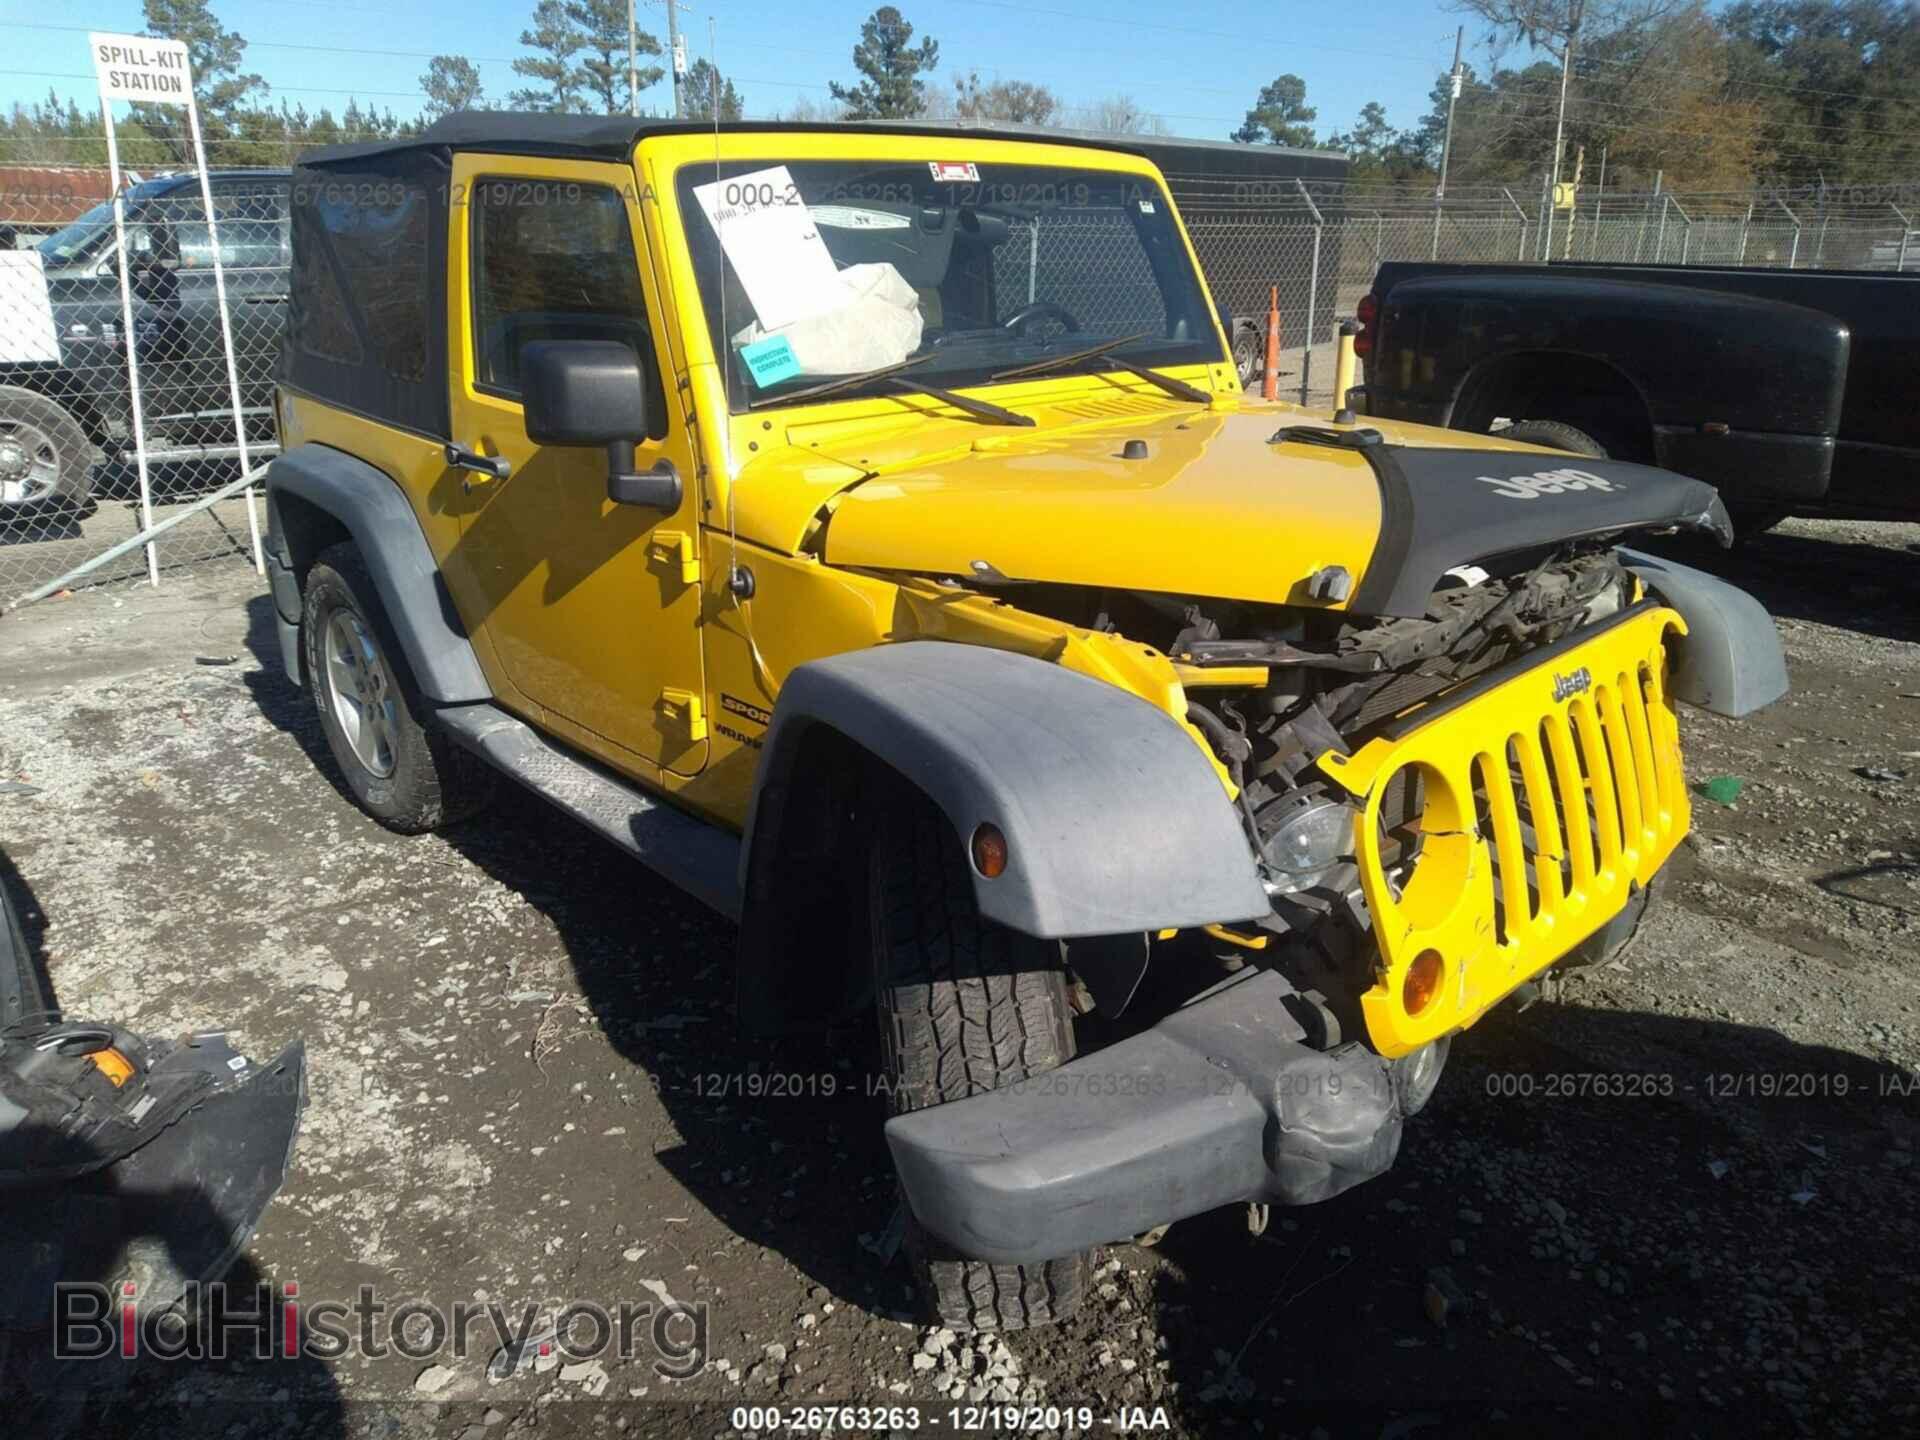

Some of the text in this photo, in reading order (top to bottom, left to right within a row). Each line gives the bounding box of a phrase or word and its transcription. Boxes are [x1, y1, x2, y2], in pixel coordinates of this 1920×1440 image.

[99, 45, 184, 69] SPILL-KIT
[110, 71, 182, 93] STATION
[1475, 468, 1616, 500] Jeep
[1552, 667, 1592, 704] Jeep
[722, 698, 771, 724] SPOR
